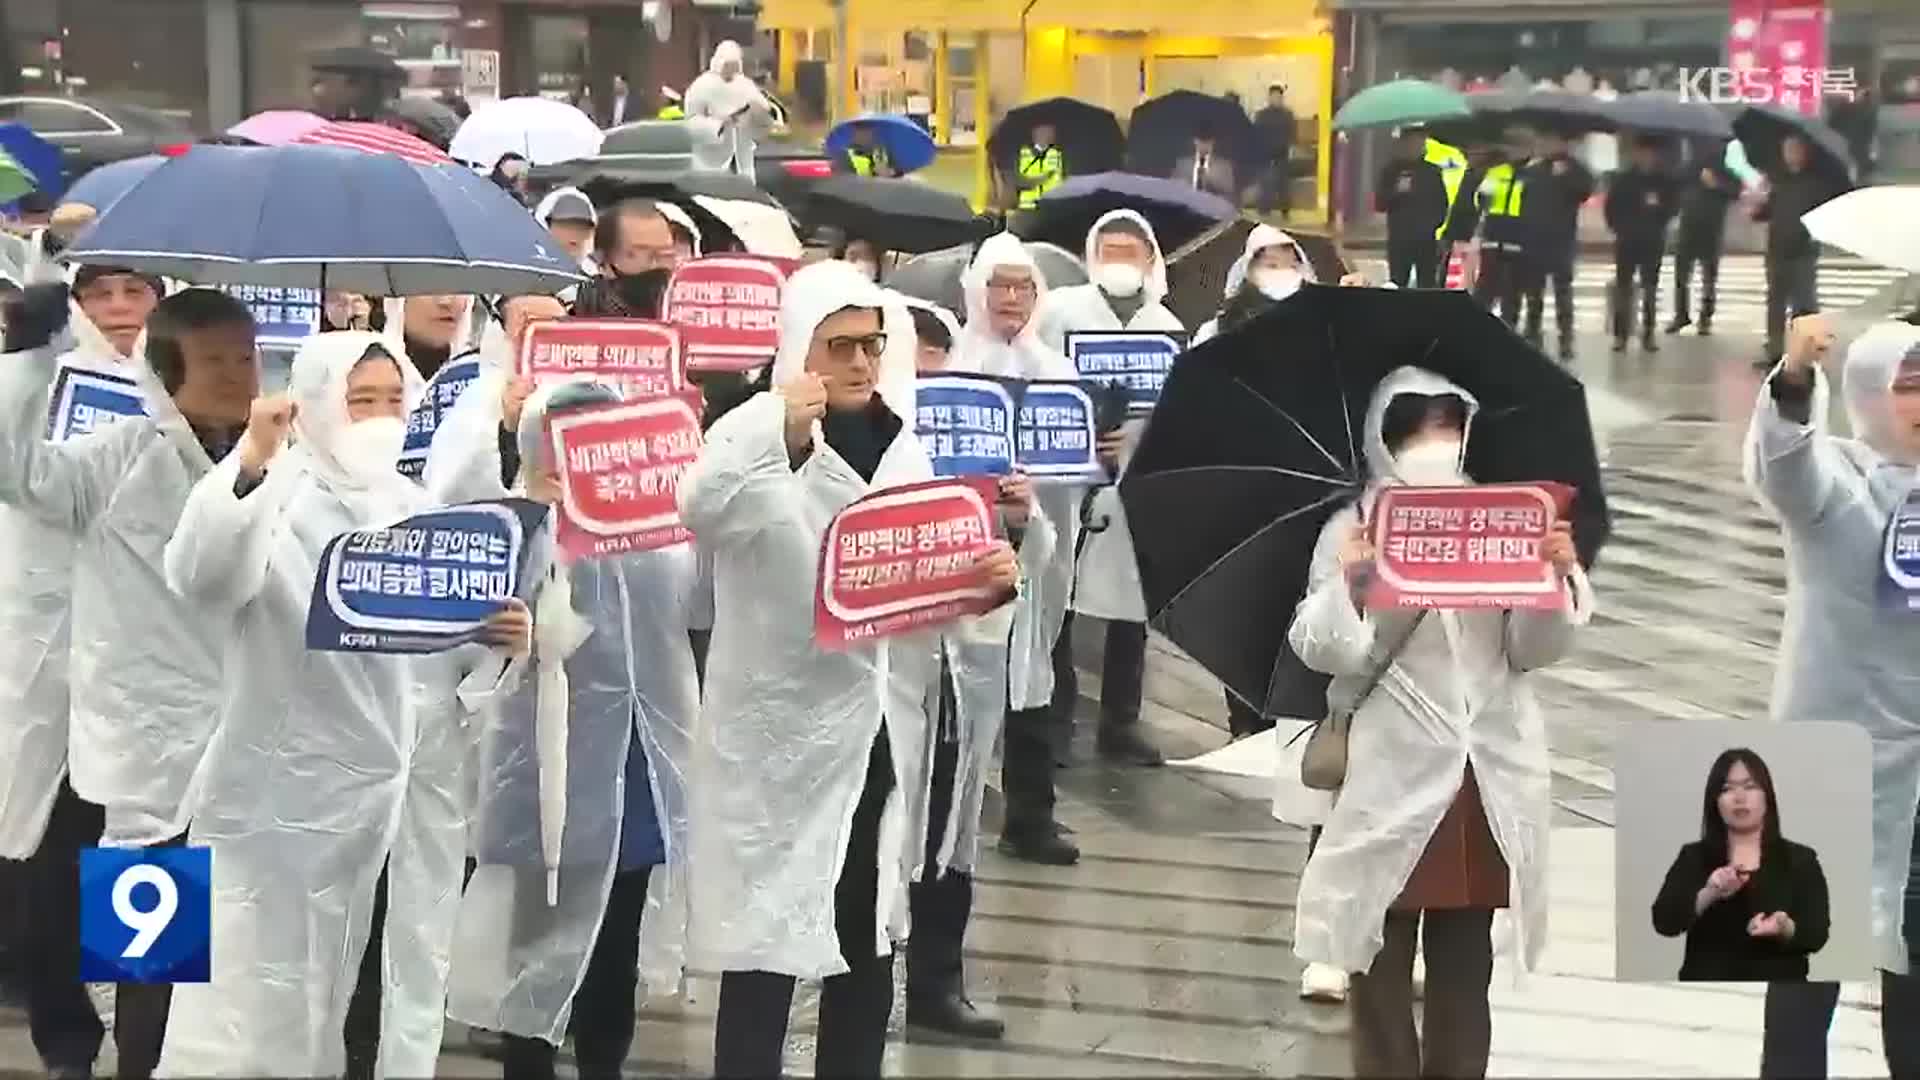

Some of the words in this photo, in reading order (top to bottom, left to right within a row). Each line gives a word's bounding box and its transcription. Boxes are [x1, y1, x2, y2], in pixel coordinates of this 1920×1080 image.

[1469, 507, 1544, 532] 정책추진
[840, 526, 913, 561] 일방적인
[1385, 536, 1460, 563] 국민건강
[340, 561, 423, 596] 의대증원
[427, 567, 510, 600] 결사반대
